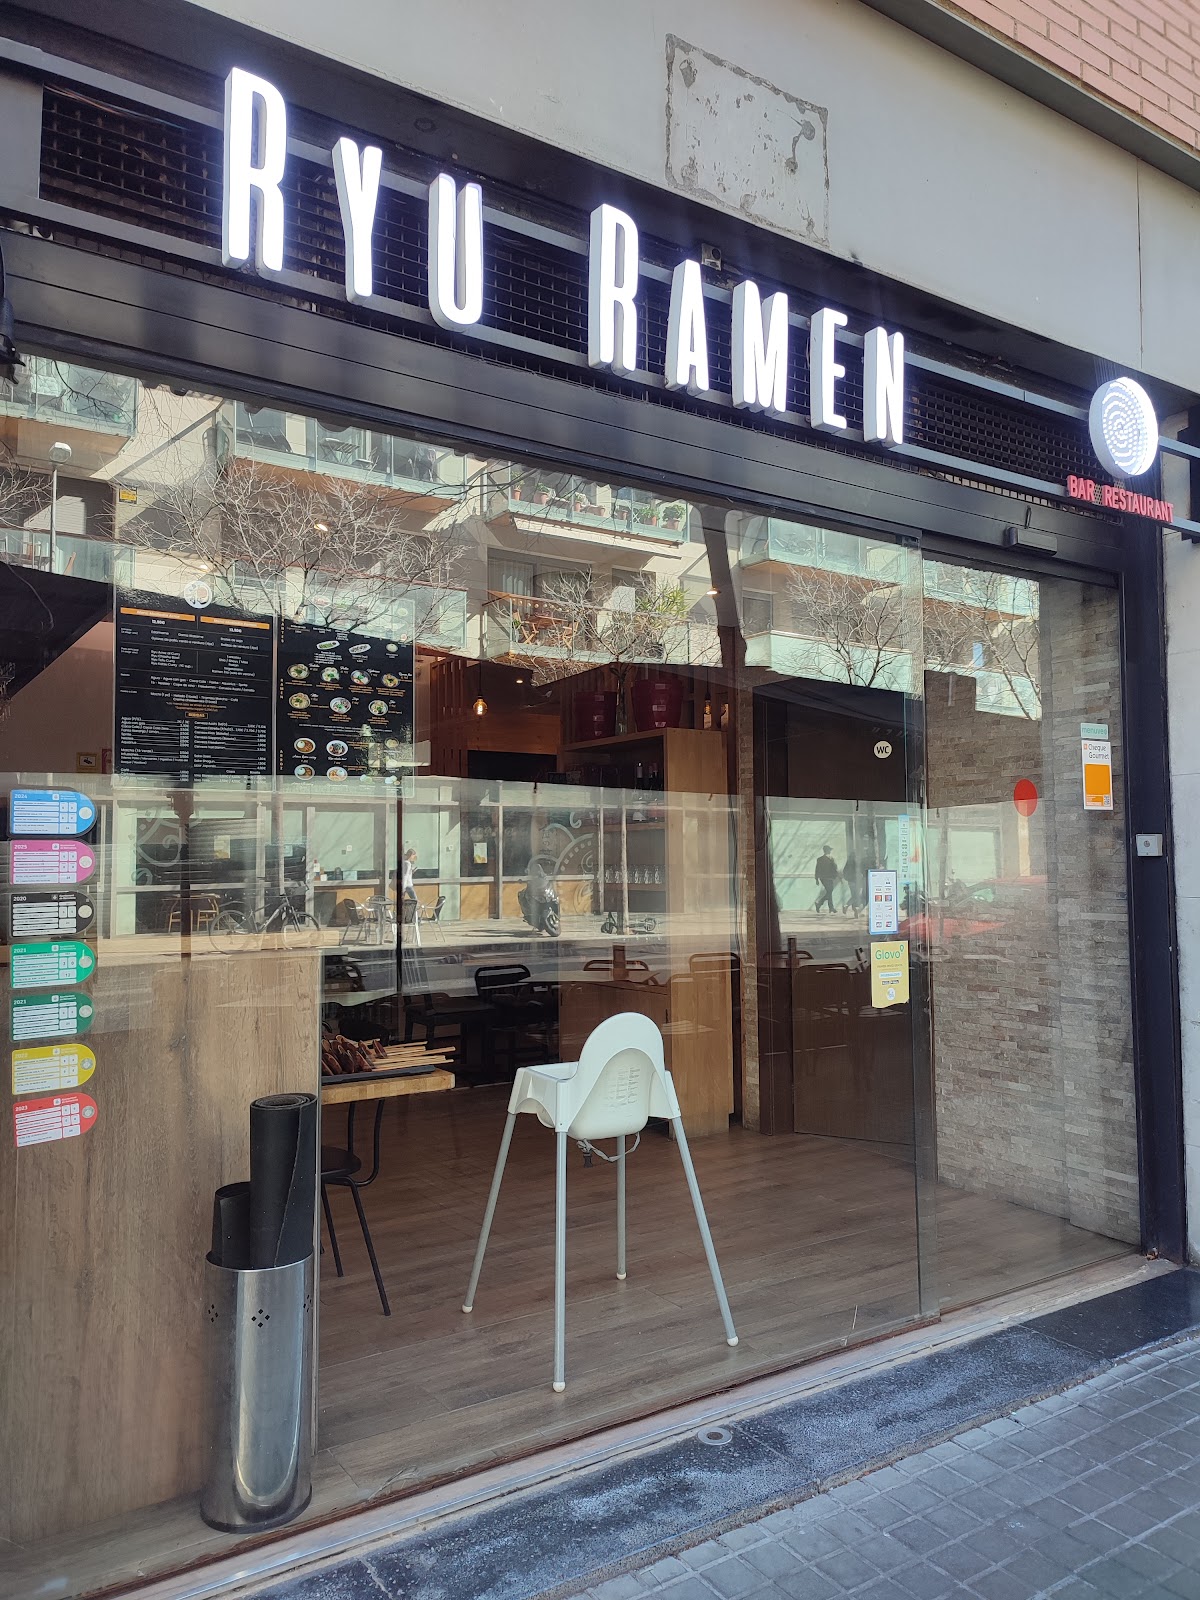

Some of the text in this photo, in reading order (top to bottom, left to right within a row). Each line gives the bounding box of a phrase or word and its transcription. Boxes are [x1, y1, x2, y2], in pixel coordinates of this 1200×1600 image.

[222, 67, 904, 447] RYU RAMEN
[1067, 474, 1173, 523] BAR RESTAURANT
[876, 746, 889, 754] WC
[1088, 743, 1106, 752] Cheque
[1089, 751, 1109, 760] Gourmet
[875, 949, 901, 960] Glovo
